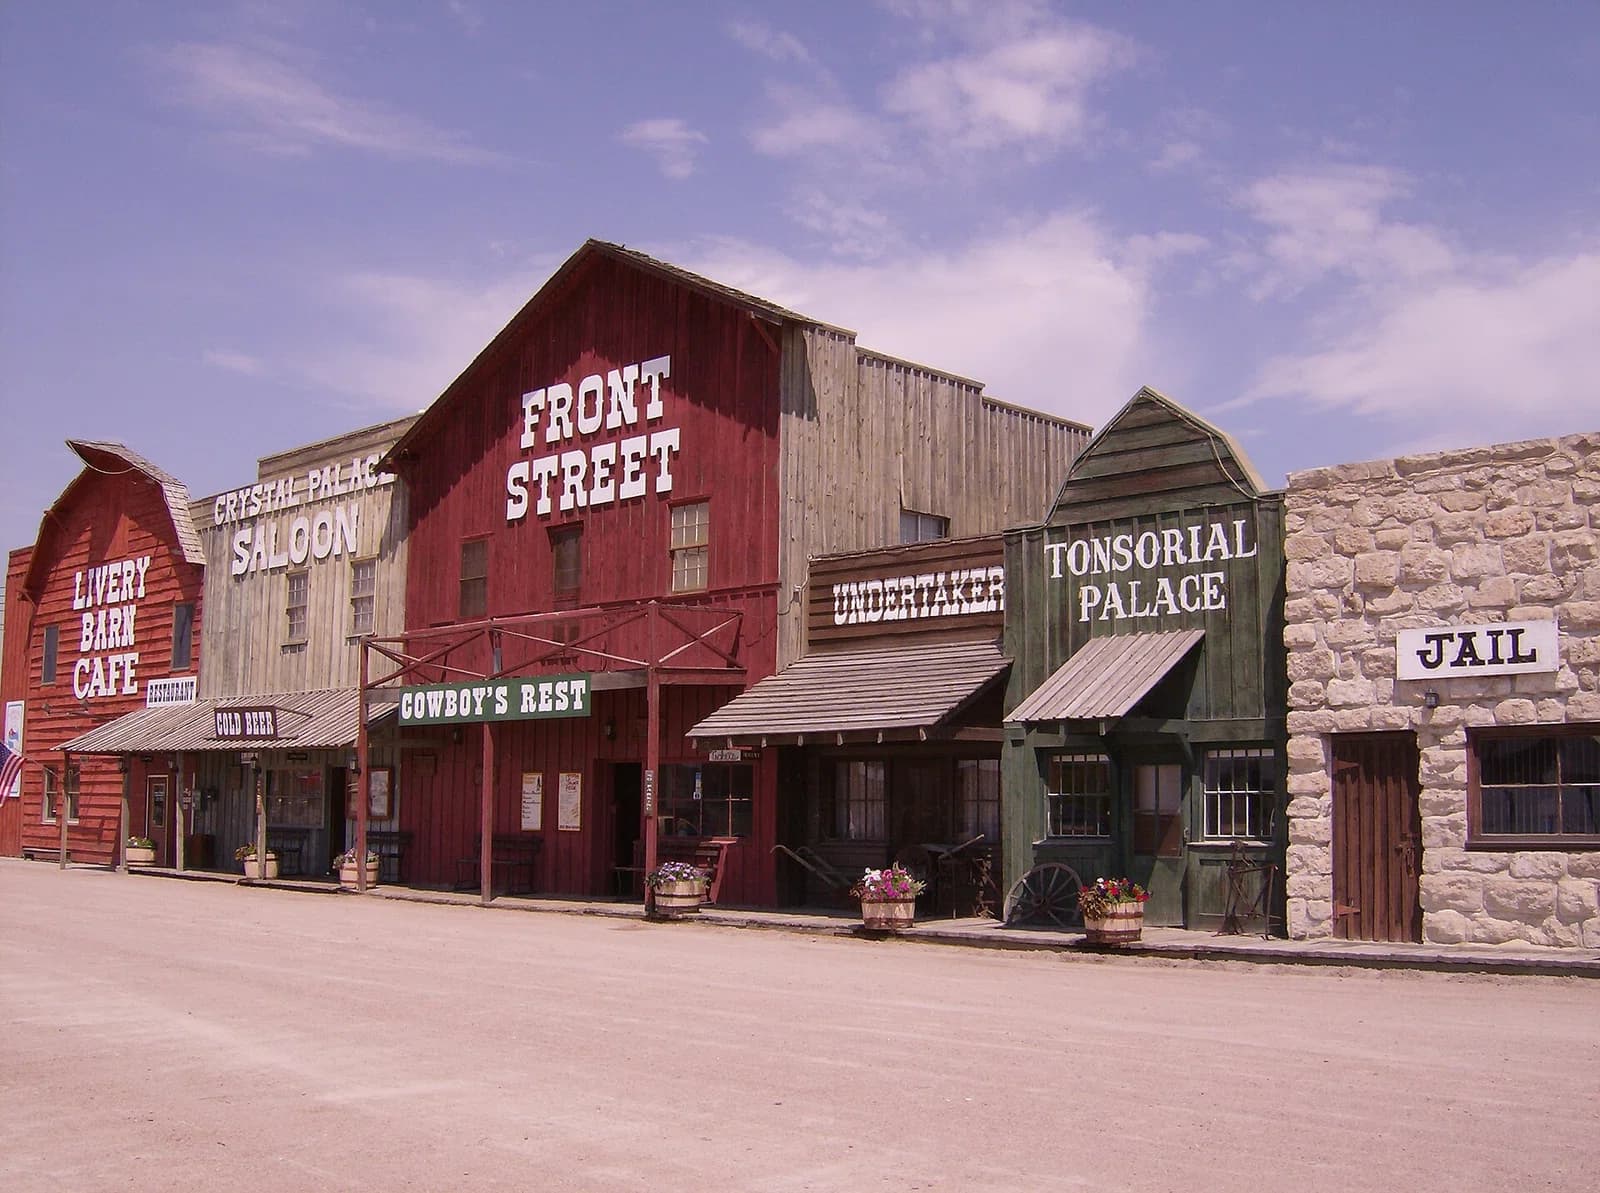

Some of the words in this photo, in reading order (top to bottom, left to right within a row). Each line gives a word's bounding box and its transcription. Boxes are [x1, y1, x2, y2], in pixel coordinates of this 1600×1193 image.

[520, 355, 671, 449] FRONT
[506, 427, 681, 520] STREET
[214, 476, 300, 525] CRYSTAL
[232, 503, 359, 576] SALOON
[1043, 519, 1257, 579] TONSORIAL
[73, 556, 151, 610] LIVERY
[832, 565, 1004, 626] UNDERTAKER
[1079, 571, 1226, 623] PALACE
[80, 604, 137, 652] BARN
[1416, 628, 1537, 670] JAIL
[73, 652, 139, 700] CAFE
[148, 681, 195, 703] RESTAURANT
[401, 686, 508, 720] COWBOY'S
[520, 679, 586, 713] REST
[216, 712, 242, 736] COLD
[245, 711, 274, 735] BEER
